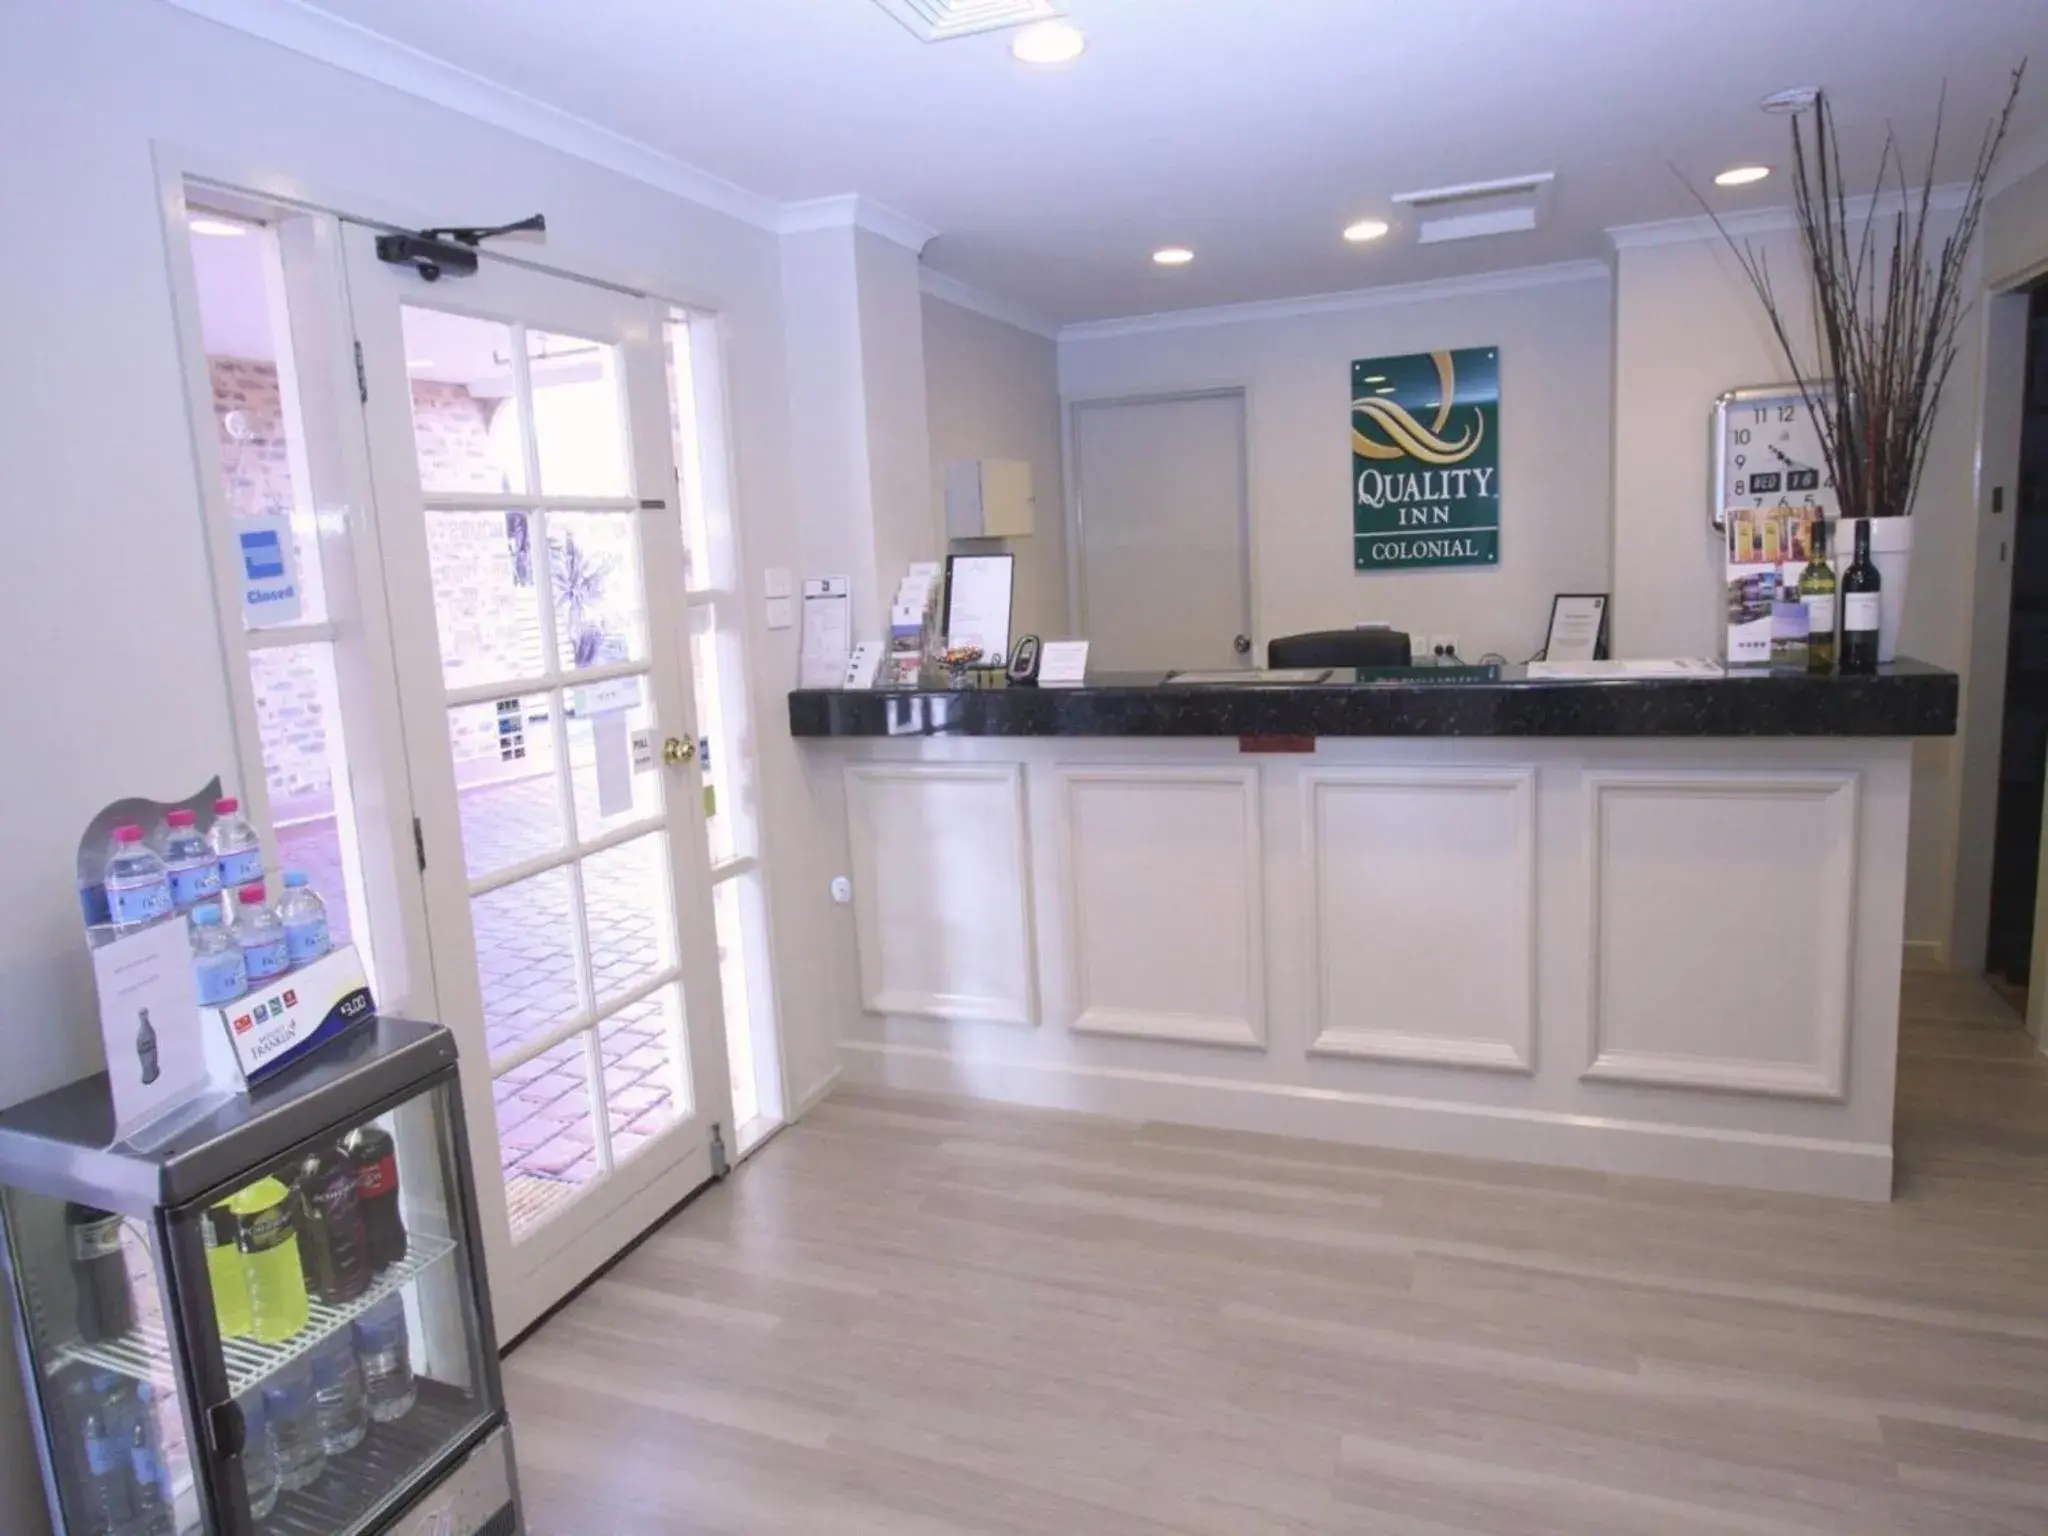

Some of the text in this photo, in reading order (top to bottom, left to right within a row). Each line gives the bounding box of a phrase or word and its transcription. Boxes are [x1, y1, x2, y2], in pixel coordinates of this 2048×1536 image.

[1754, 407, 1767, 424] 11
[1777, 405, 1794, 422] 12
[1734, 428, 1751, 445] 10
[1734, 454, 1746, 470] 9
[1358, 467, 1494, 508] QUALITY
[1734, 480, 1745, 496] 8
[1398, 506, 1450, 525] INN
[1372, 539, 1479, 560] COLONIAL
[246, 585, 294, 605] Closed
